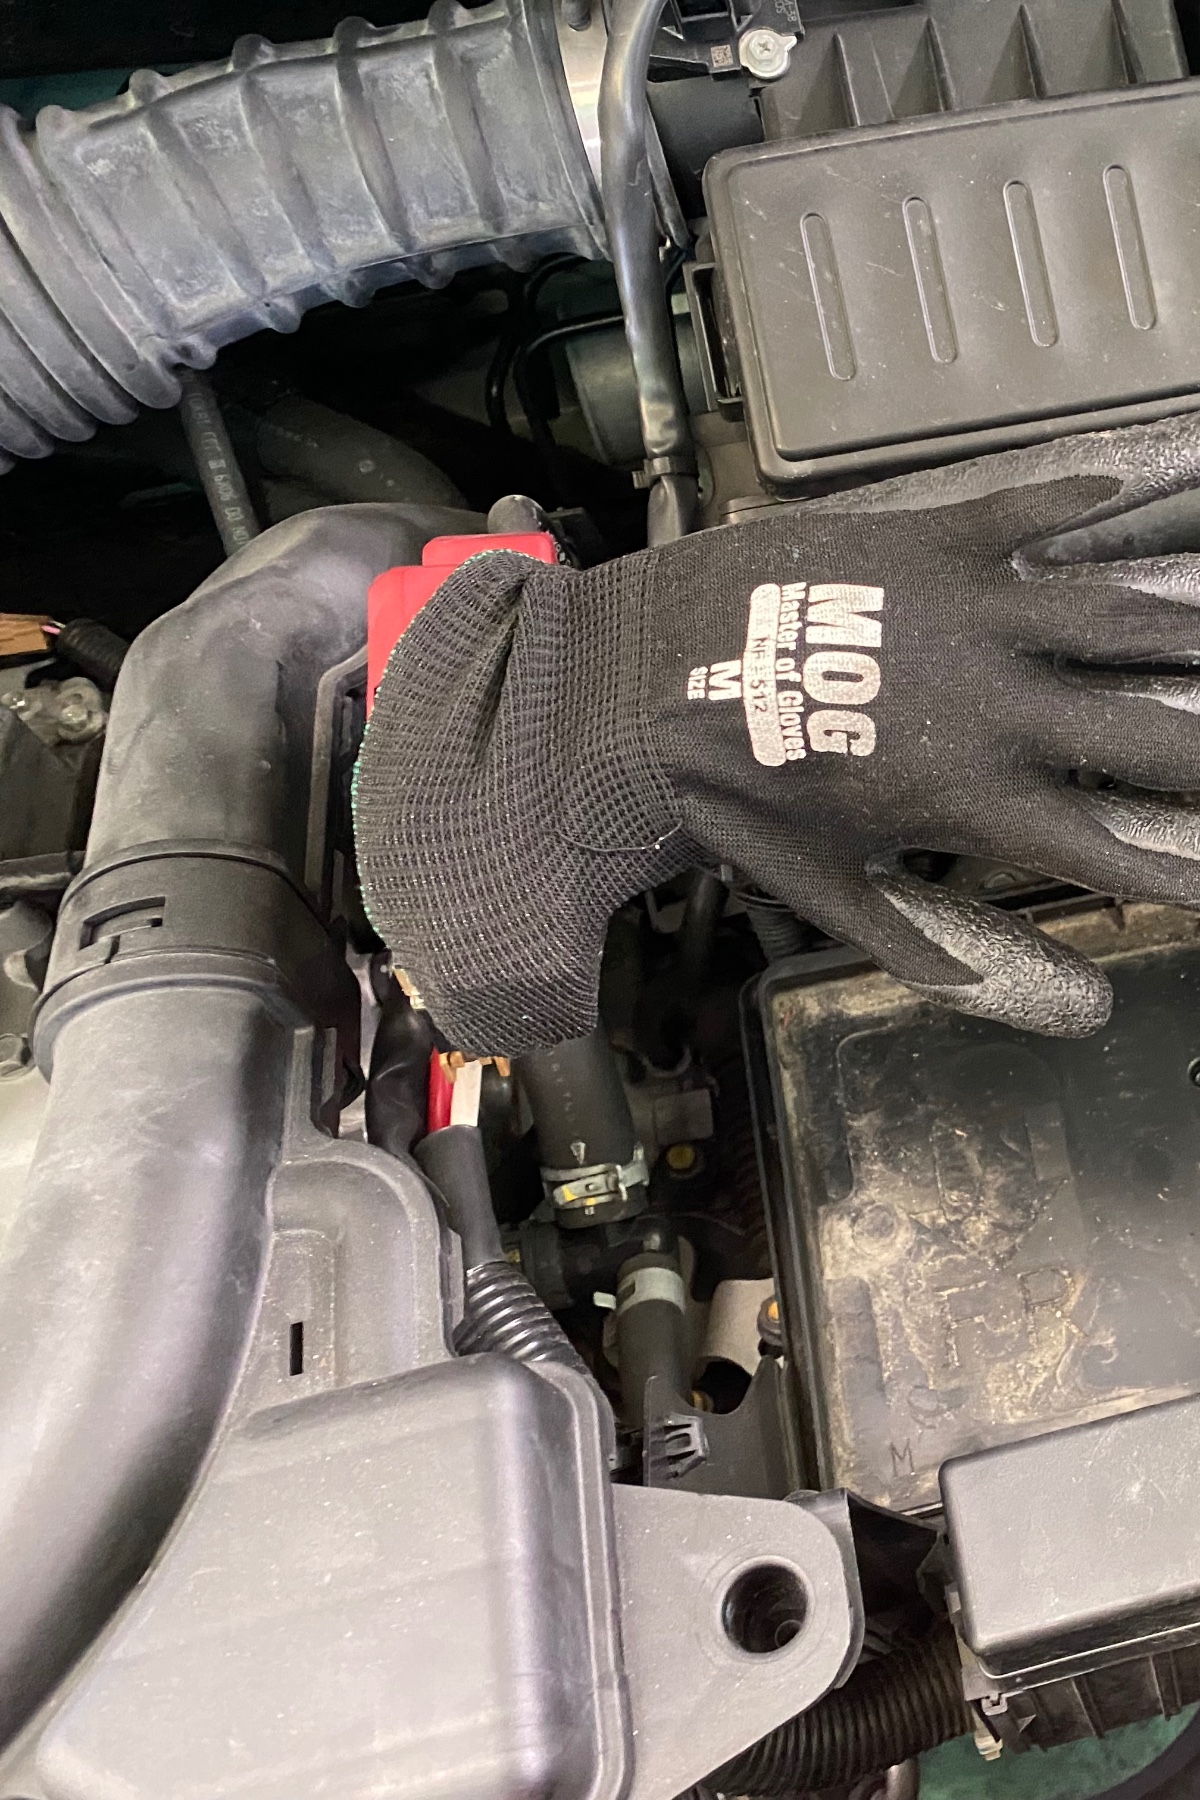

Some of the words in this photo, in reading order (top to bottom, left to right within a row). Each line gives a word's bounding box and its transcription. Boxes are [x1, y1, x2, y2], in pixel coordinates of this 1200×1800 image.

[775, 582, 807, 651] Master
[687, 666, 708, 700] SIZE
[707, 659, 742, 701] M
[775, 656, 802, 683] of
[804, 583, 885, 757] MOG
[777, 690, 807, 761] Gloves
